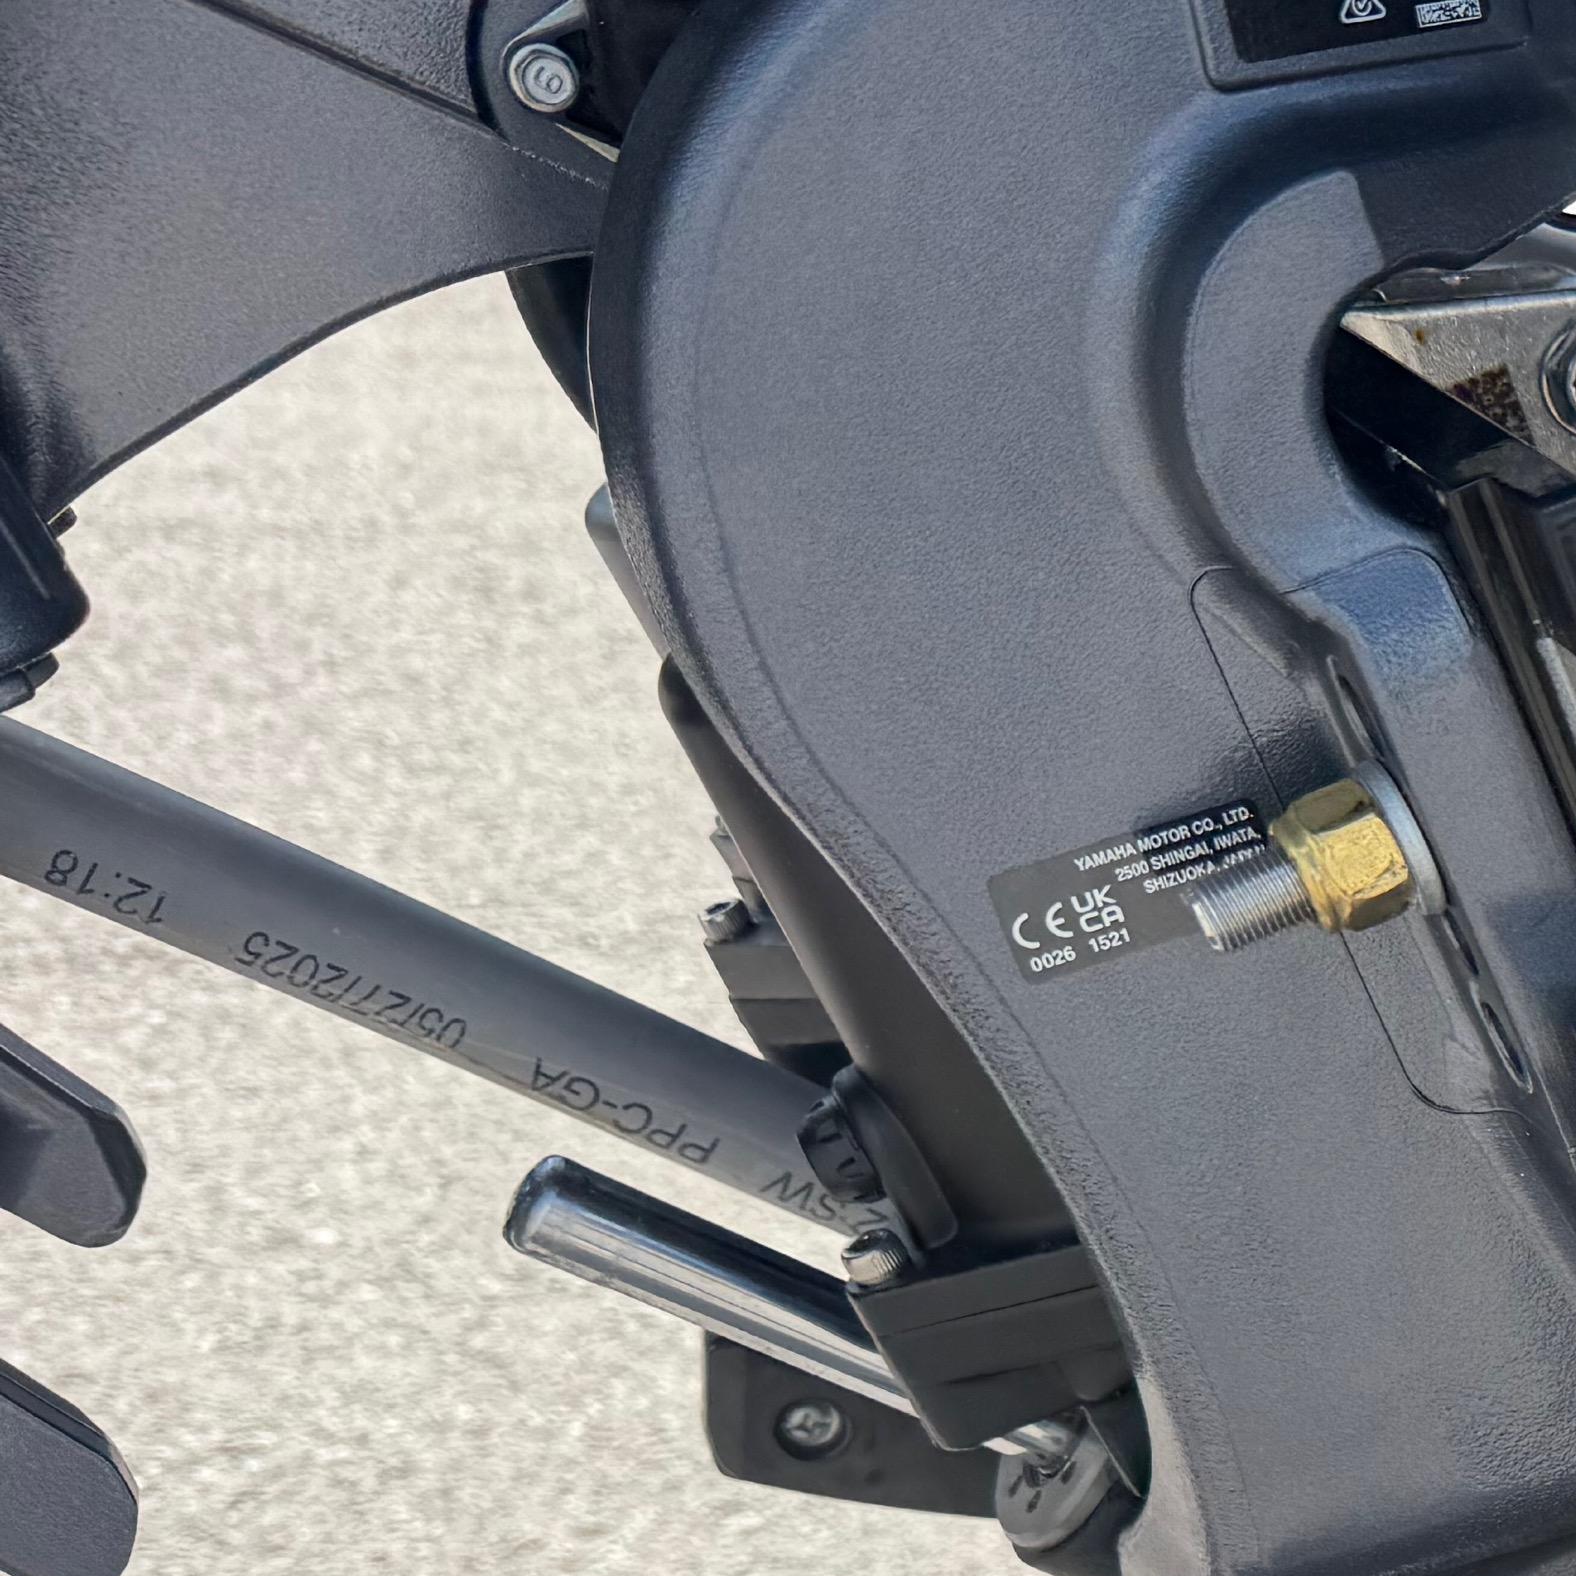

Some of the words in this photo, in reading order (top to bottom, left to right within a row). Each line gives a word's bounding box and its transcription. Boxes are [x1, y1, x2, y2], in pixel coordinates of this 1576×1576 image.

[1073, 842, 1137, 872] YAMAHA
[1136, 824, 1192, 853] MOTOR
[1190, 816, 1223, 837] CO.,
[1221, 805, 1255, 827] LTD.
[1114, 860, 1150, 882] 2500
[1150, 841, 1214, 872] SHINGAI,
[1213, 825, 1262, 850] IWATA,
[43, 848, 169, 928] 12:18
[1070, 883, 1118, 914] UK
[1078, 904, 1126, 933] CA
[1029, 945, 1077, 973] 0026
[1088, 927, 1131, 953] 1521
[234, 929, 469, 1051] 05/27/2025
[529, 1056, 721, 1165] PPC-GA
